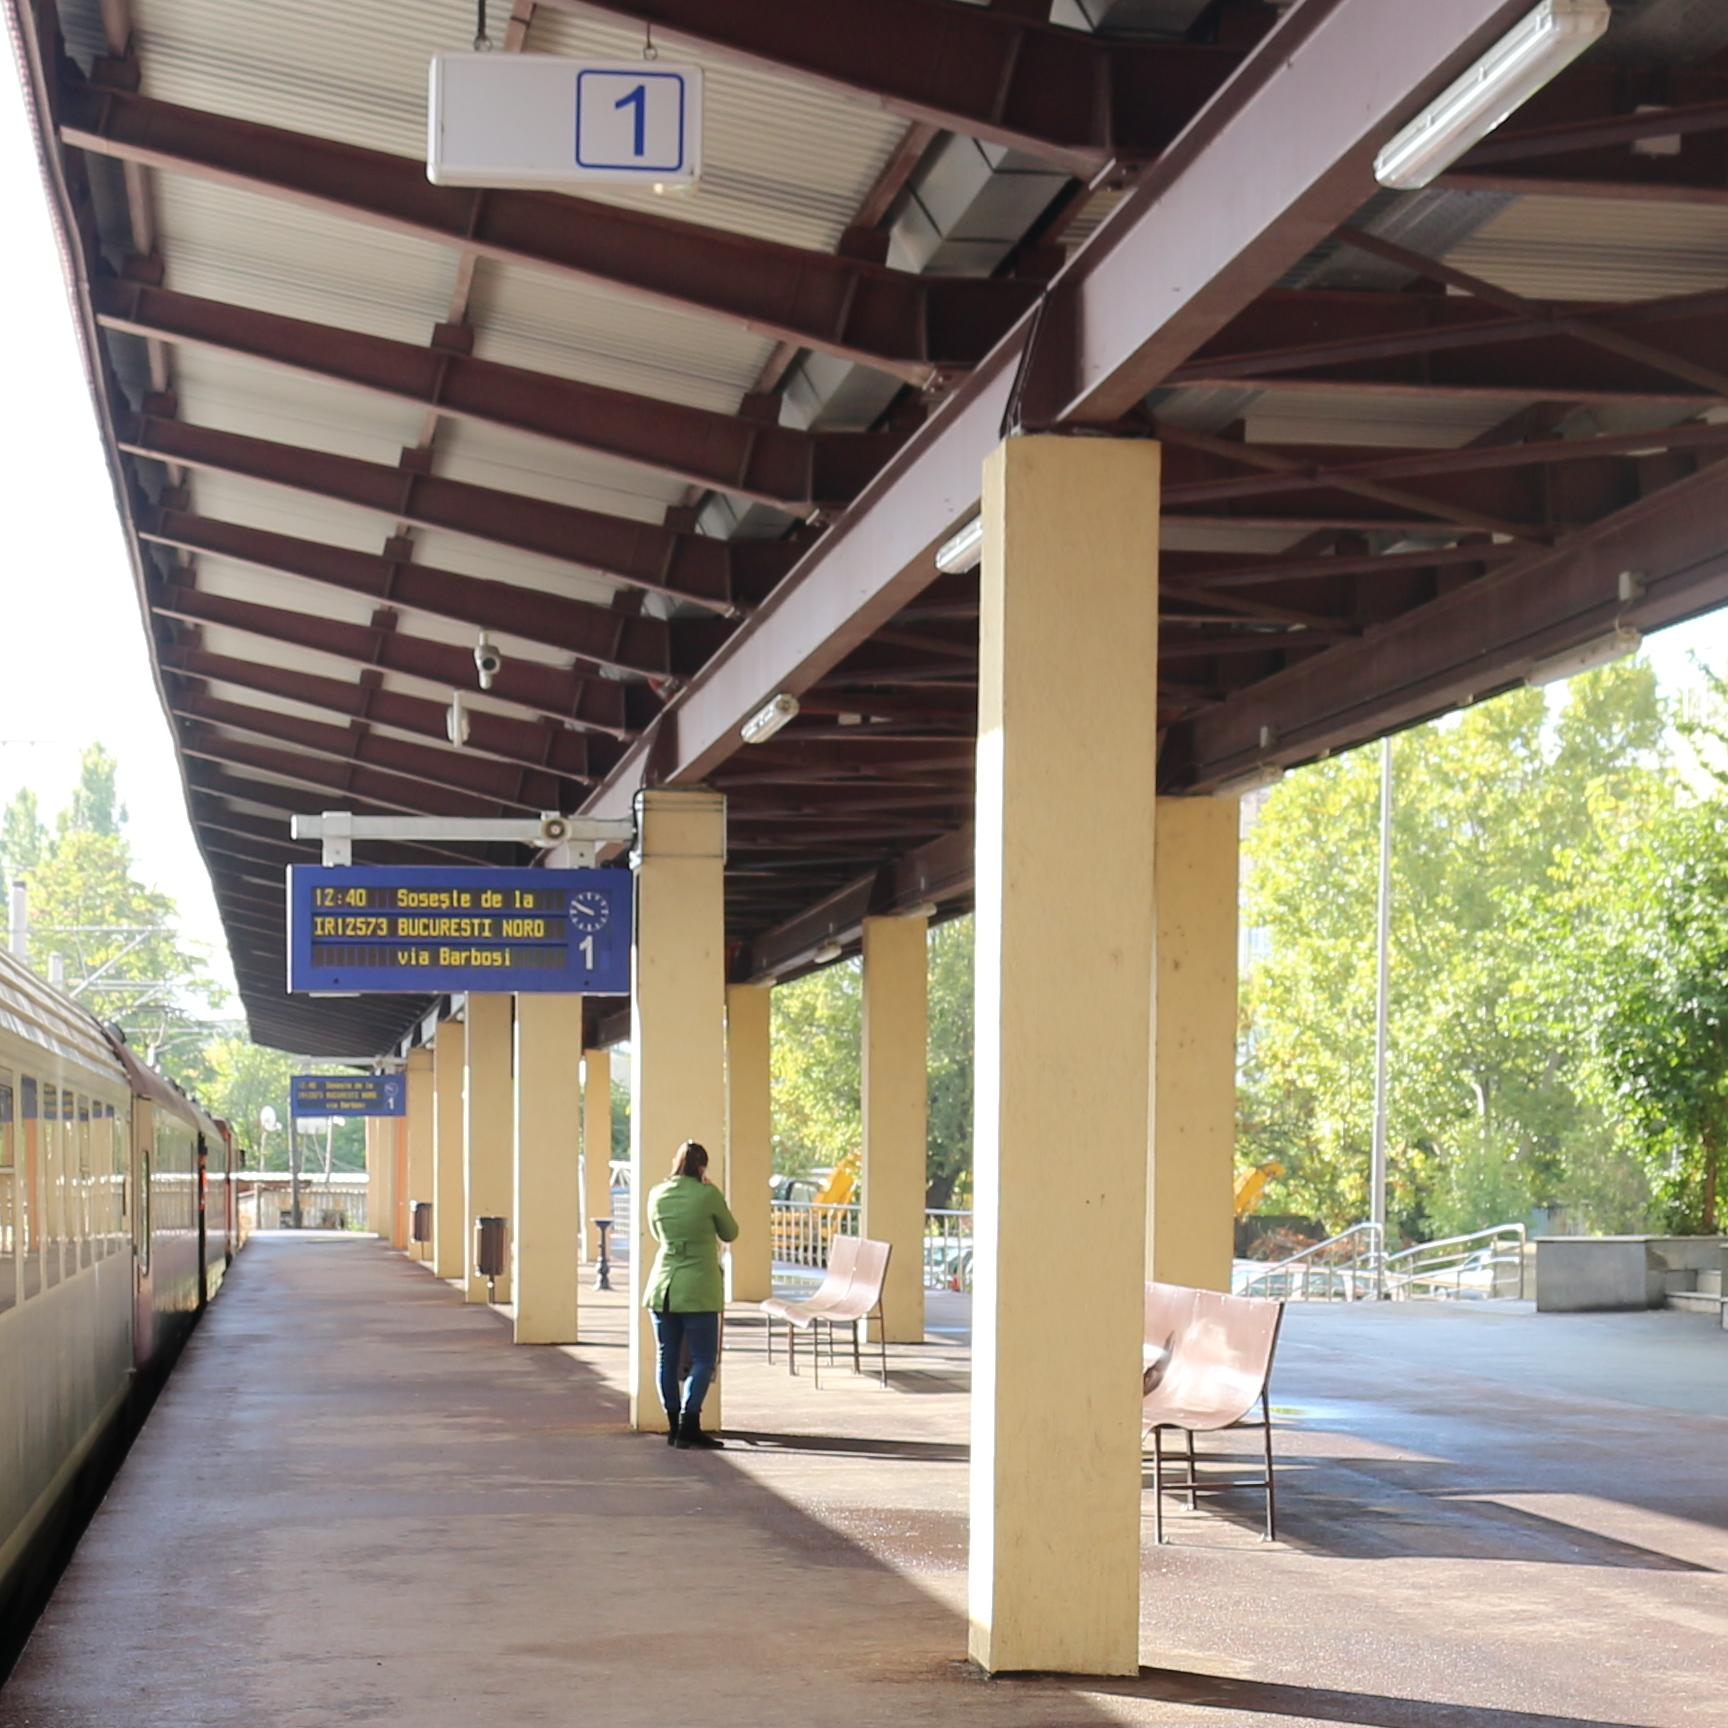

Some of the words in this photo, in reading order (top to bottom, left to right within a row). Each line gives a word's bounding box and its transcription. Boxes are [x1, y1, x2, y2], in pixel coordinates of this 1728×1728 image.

[615, 84, 645, 157] 1
[315, 887, 366, 907] 12:40
[480, 889, 503, 908] de
[514, 889, 534, 909] la
[314, 916, 388, 936] IR12573
[398, 917, 492, 937] BUCURESTI
[502, 918, 545, 938] NORD
[397, 947, 430, 966] via
[439, 947, 511, 967] Barbosi
[579, 935, 594, 970] 1
